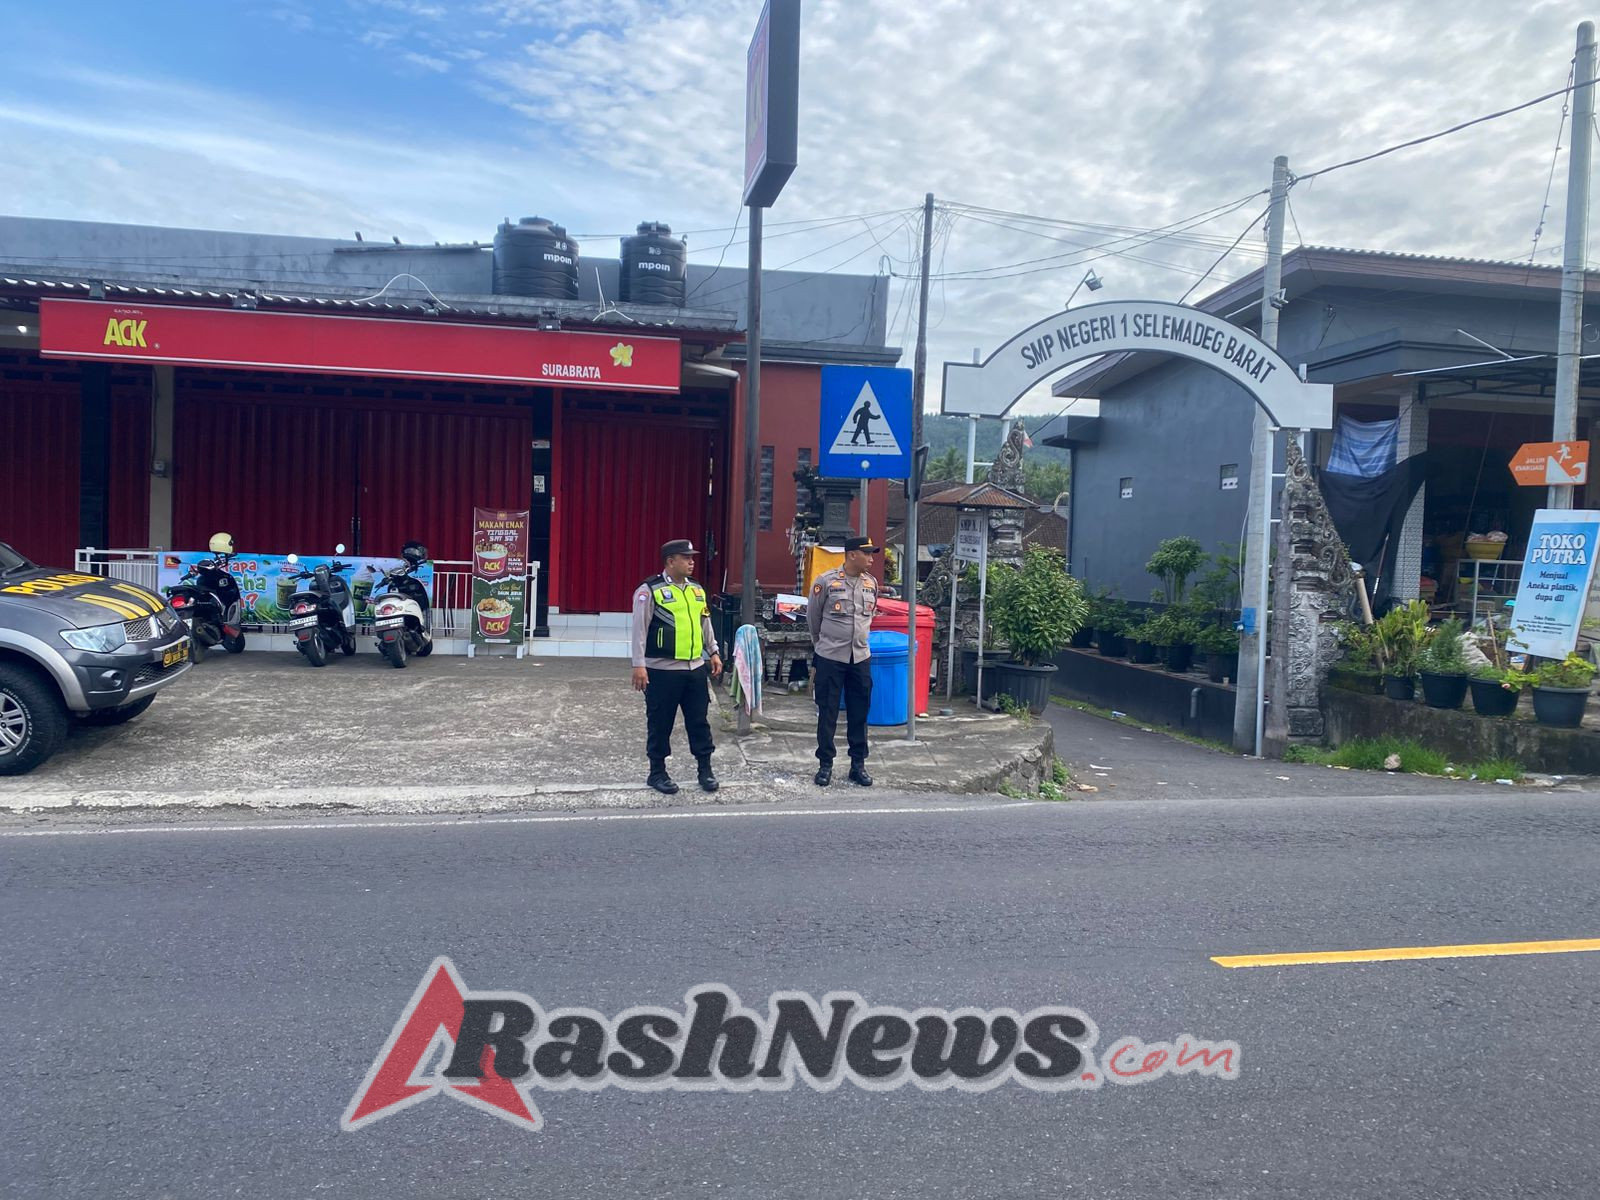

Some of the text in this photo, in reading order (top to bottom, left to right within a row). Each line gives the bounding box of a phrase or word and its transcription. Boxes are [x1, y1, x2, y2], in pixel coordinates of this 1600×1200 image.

[103, 317, 147, 348] ACK
[1020, 313, 1278, 384] SMP NEGERI 1 SELEMADEG BARAT
[541, 362, 601, 379] SURABRATA
[479, 520, 525, 529] MAKAN ENAK
[1540, 533, 1586, 549] TOKO
[1531, 548, 1587, 565] PUTRA
[484, 561, 501, 570] ACK
[1540, 571, 1569, 580] Menjual
[1535, 593, 1553, 602] dupa
[485, 621, 505, 631] ACK
